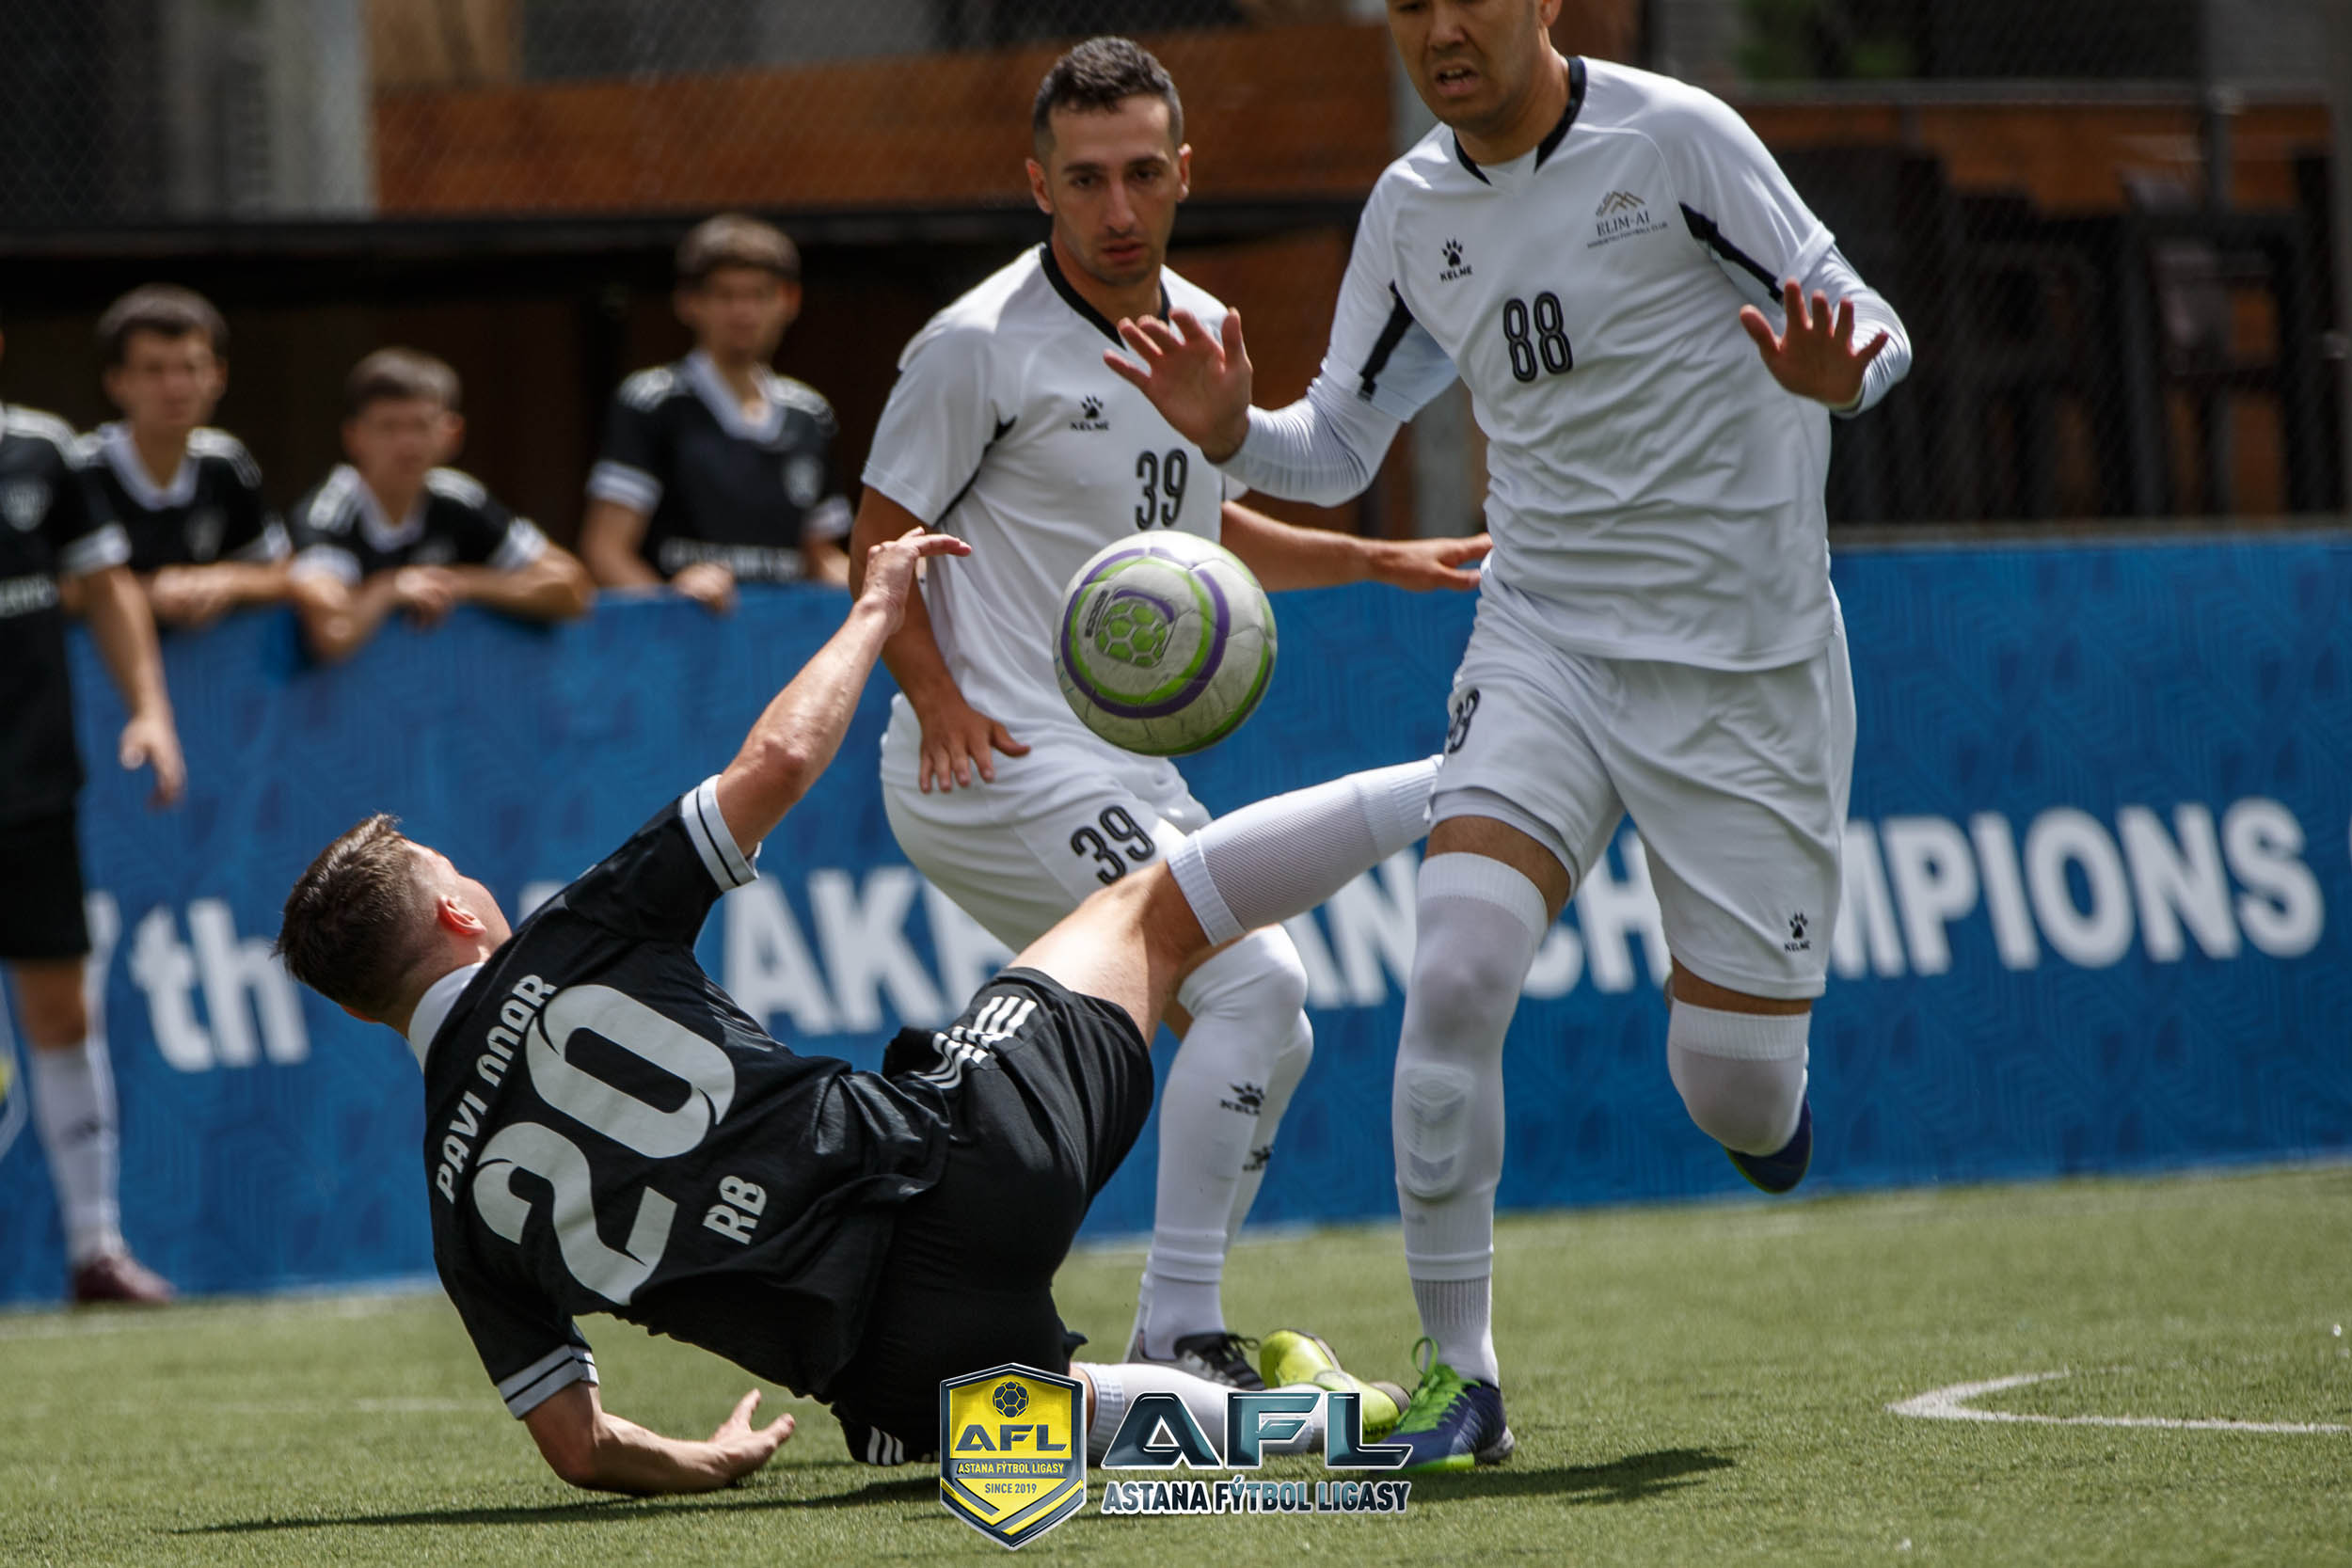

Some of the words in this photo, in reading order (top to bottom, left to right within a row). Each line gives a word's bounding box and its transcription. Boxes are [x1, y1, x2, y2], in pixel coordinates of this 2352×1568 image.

[1439, 264, 1473, 281] KELME
[1503, 292, 1574, 383] 88
[1136, 448, 1188, 531] 39
[1070, 805, 1156, 885] 39
[473, 984, 736, 1307] 20
[702, 1175, 768, 1245] RB
